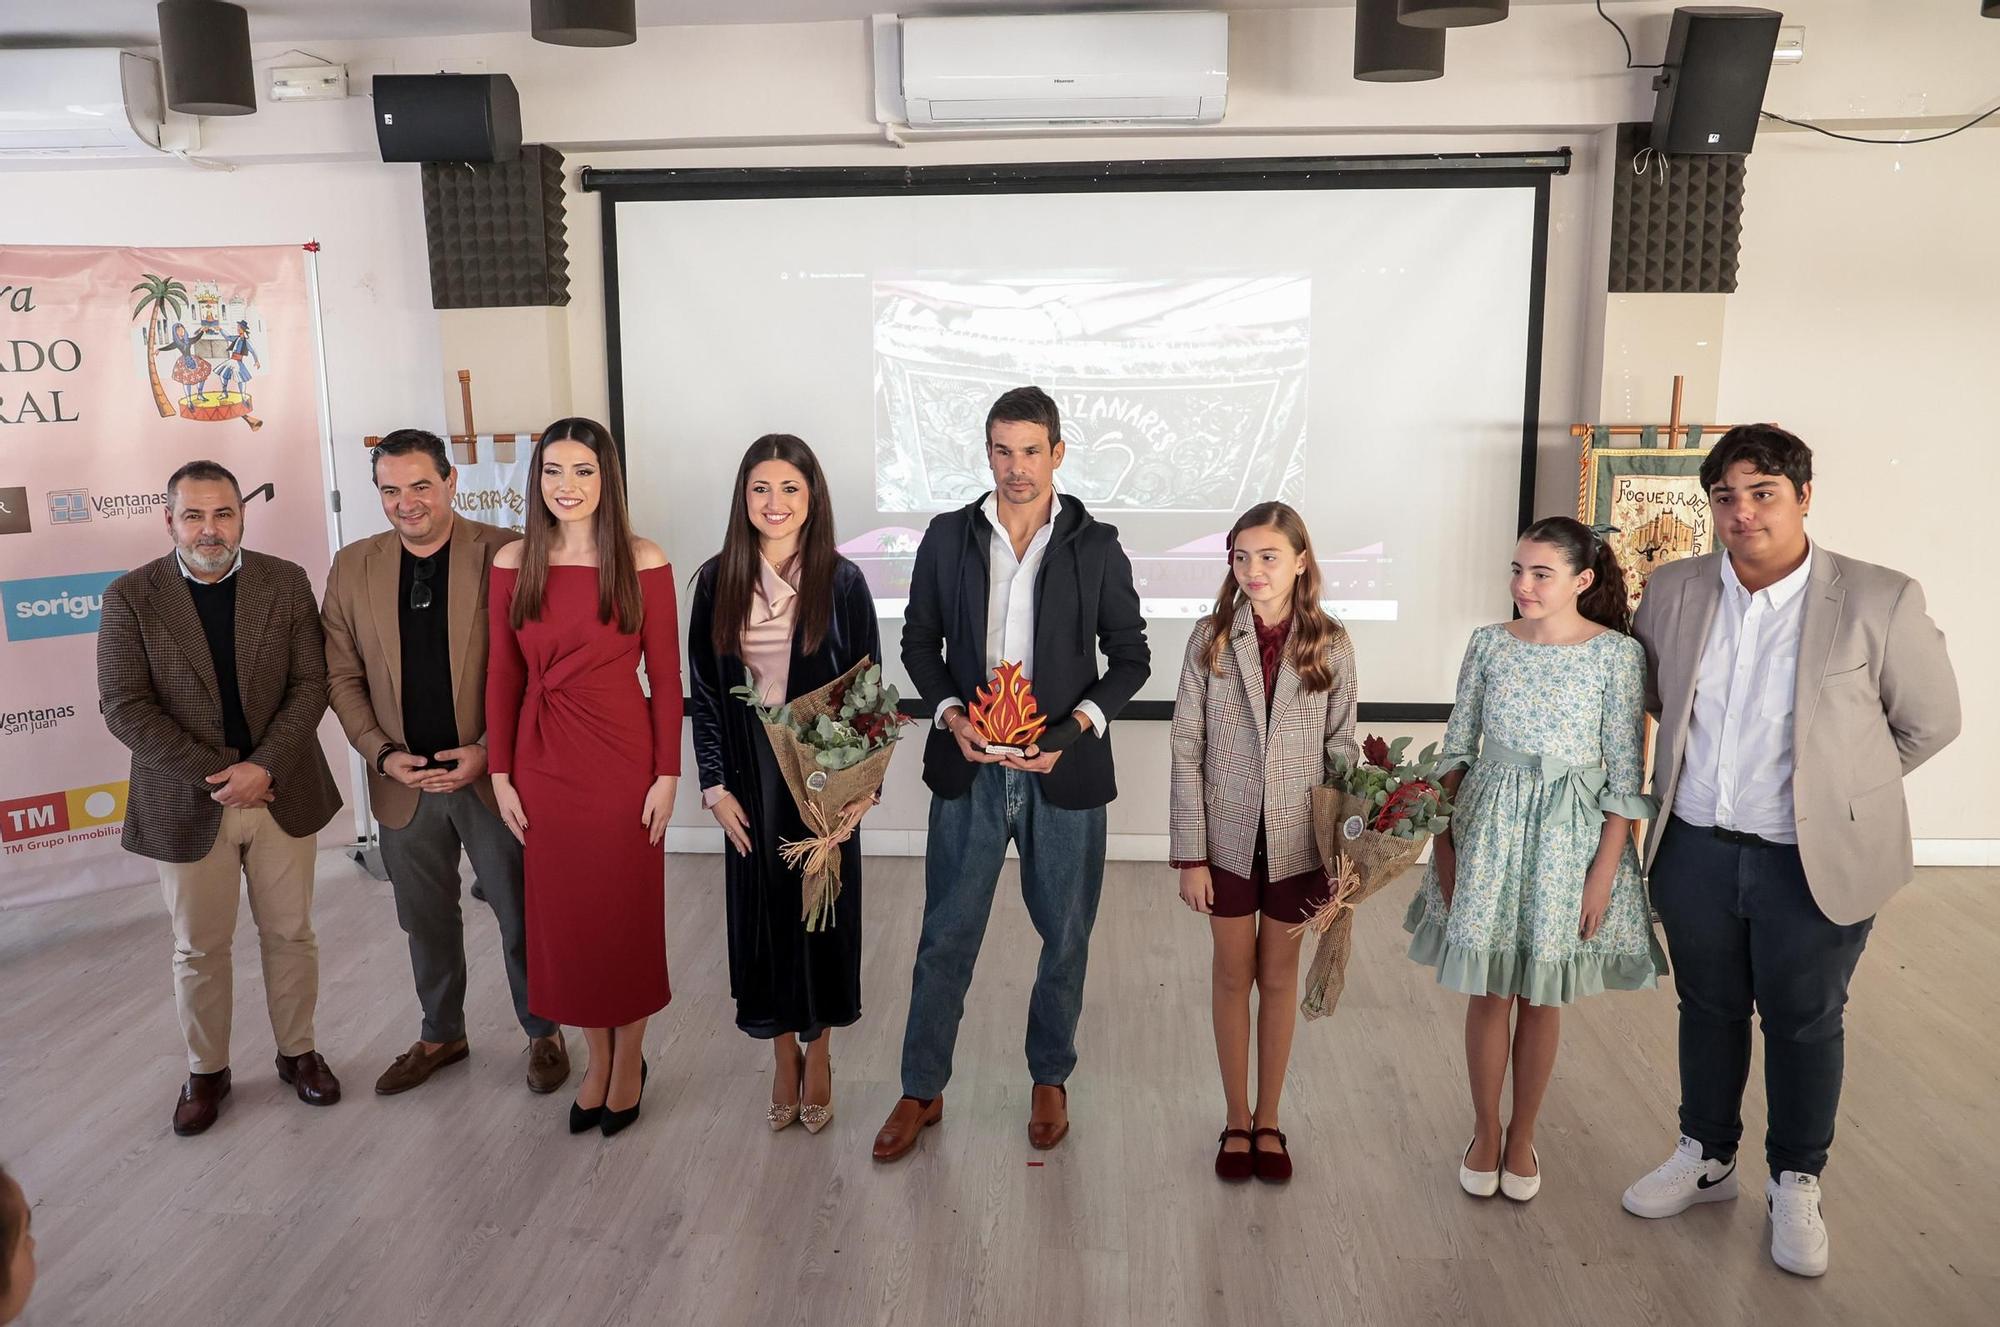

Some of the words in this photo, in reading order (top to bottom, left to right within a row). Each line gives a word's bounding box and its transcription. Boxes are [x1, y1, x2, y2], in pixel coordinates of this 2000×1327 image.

[0, 339, 82, 373] DO
[91, 492, 168, 512] Ventanas
[1616, 480, 1687, 506] FOGUERA
[1686, 494, 1708, 518] DEL
[102, 507, 124, 519] San
[4, 723, 28, 736] San
[8, 805, 55, 832] TM
[4, 844, 24, 855] TM
[27, 837, 64, 851] Grupo
